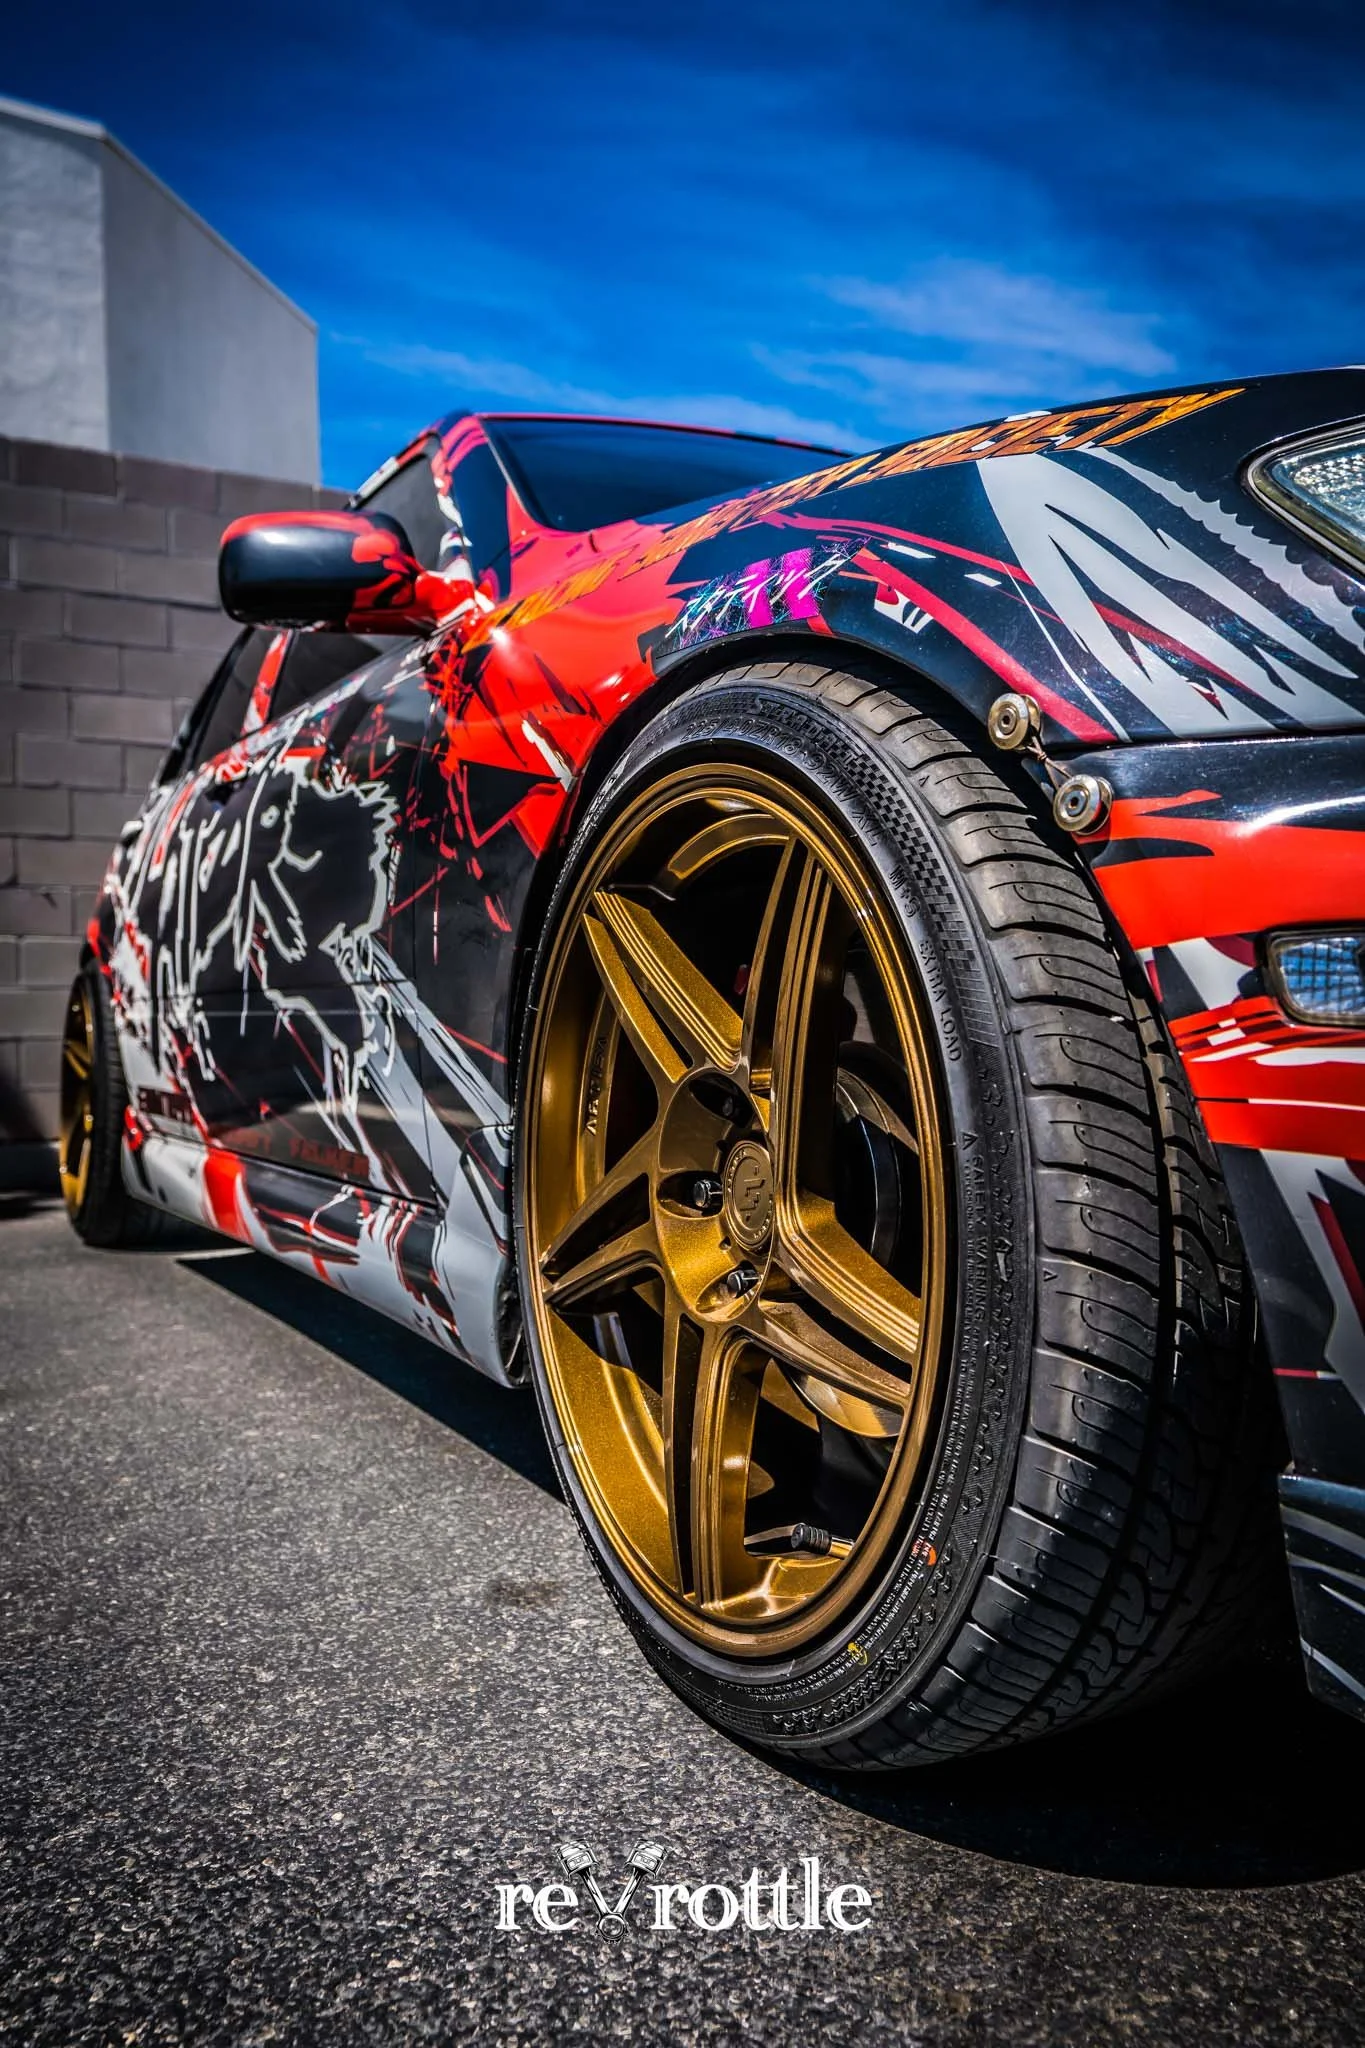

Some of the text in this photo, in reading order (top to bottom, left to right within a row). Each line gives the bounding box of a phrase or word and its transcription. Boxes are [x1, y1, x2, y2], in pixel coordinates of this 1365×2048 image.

[837, 387, 1247, 490] SOCIETY
[665, 553, 852, 639] スタティック
[889, 865, 920, 918] M+S
[918, 940, 962, 1061] EXTRA LOAD
[974, 1235, 989, 1322] WARNING
